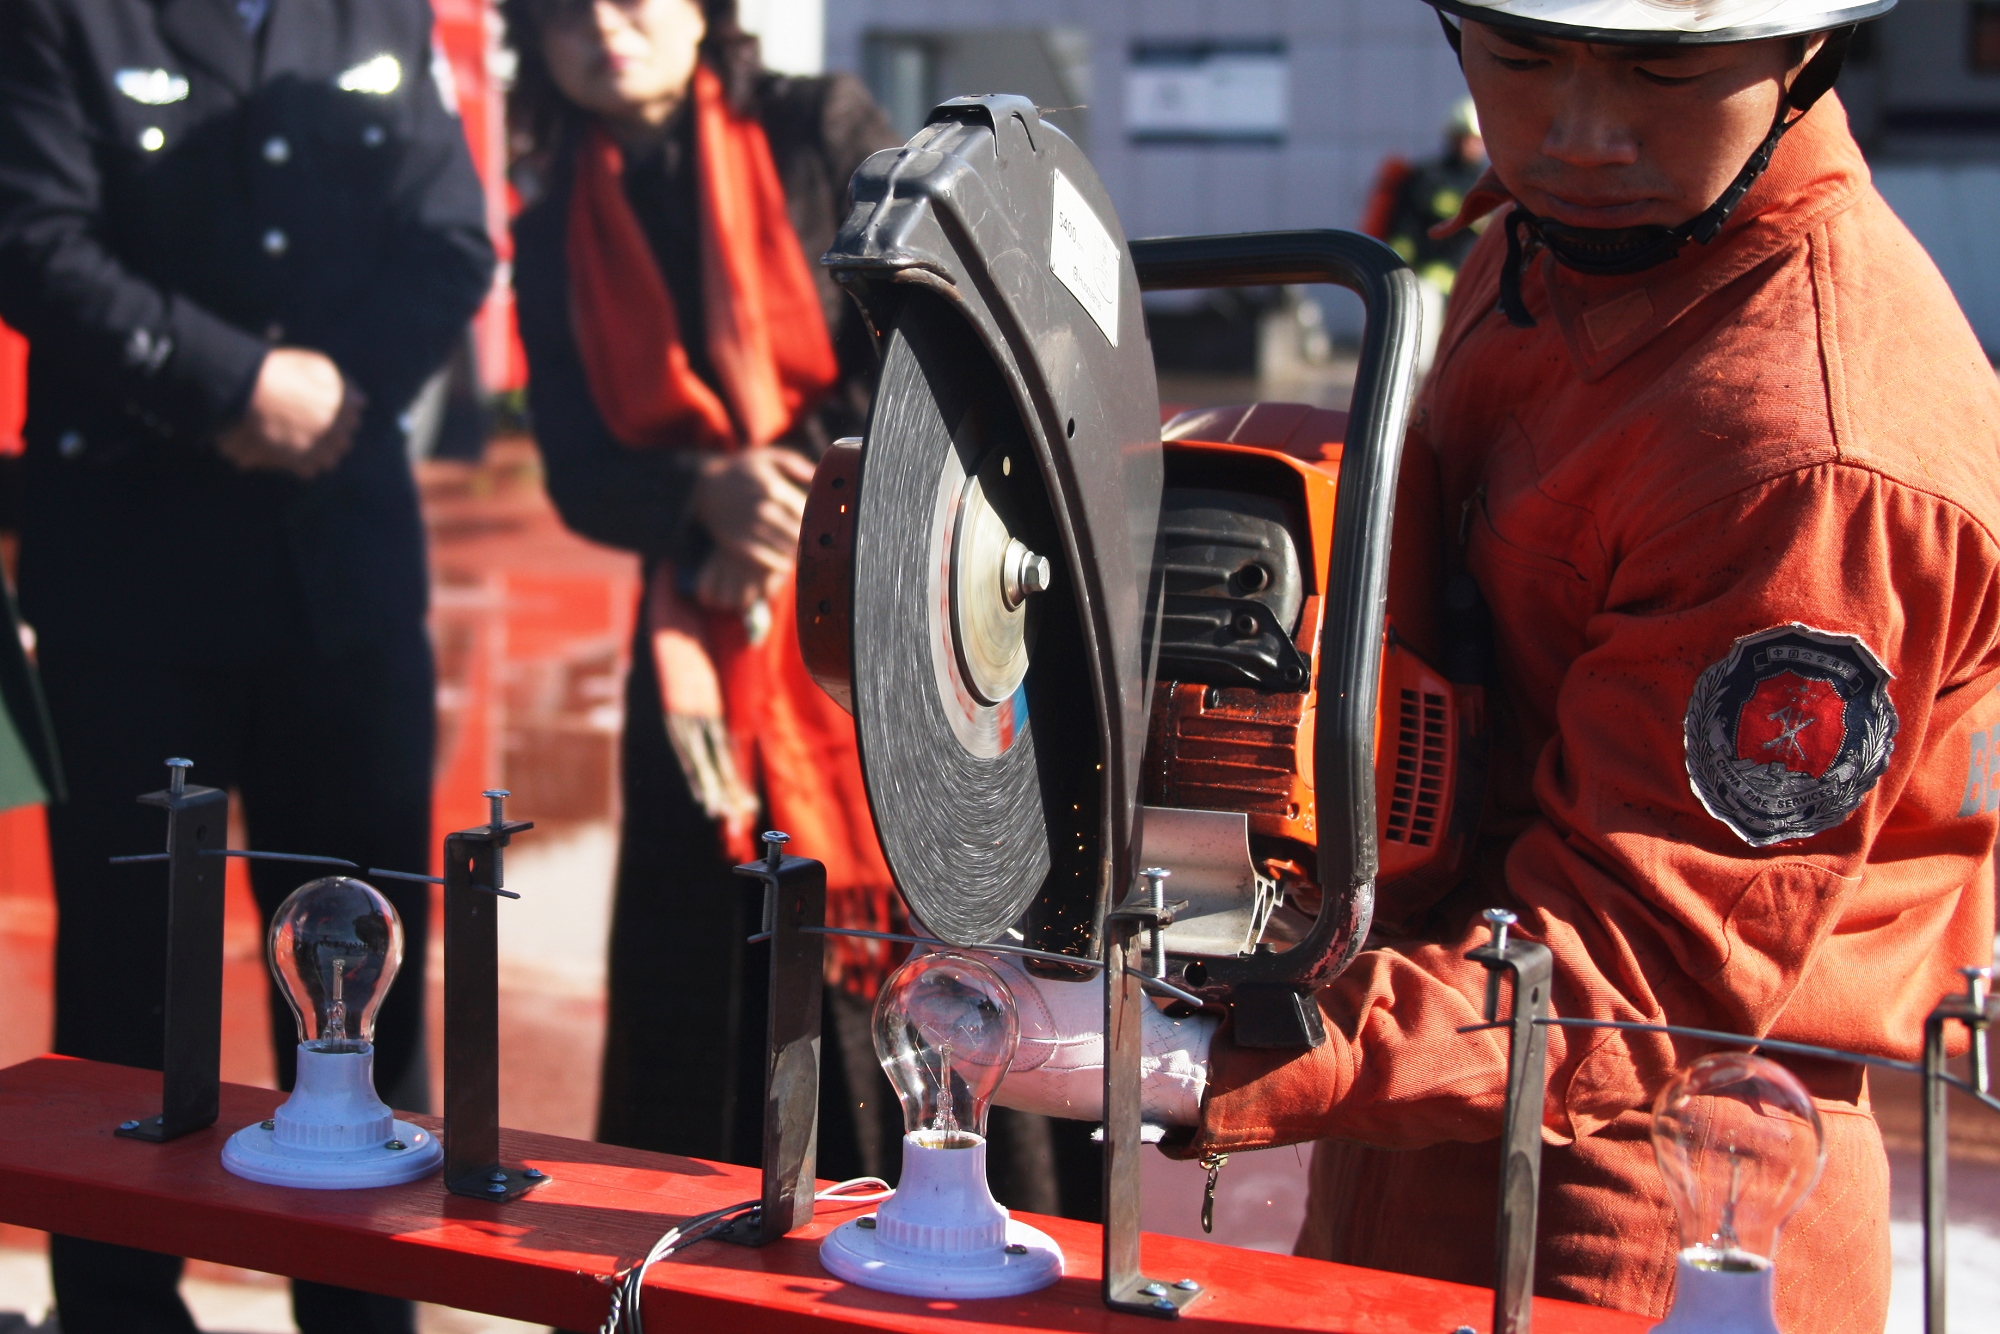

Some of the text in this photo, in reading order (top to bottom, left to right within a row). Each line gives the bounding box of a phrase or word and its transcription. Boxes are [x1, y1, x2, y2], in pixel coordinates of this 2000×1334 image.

[1058, 211, 1077, 243] 5400
[1716, 759, 1835, 809] CHINA FIRE SERVICES
